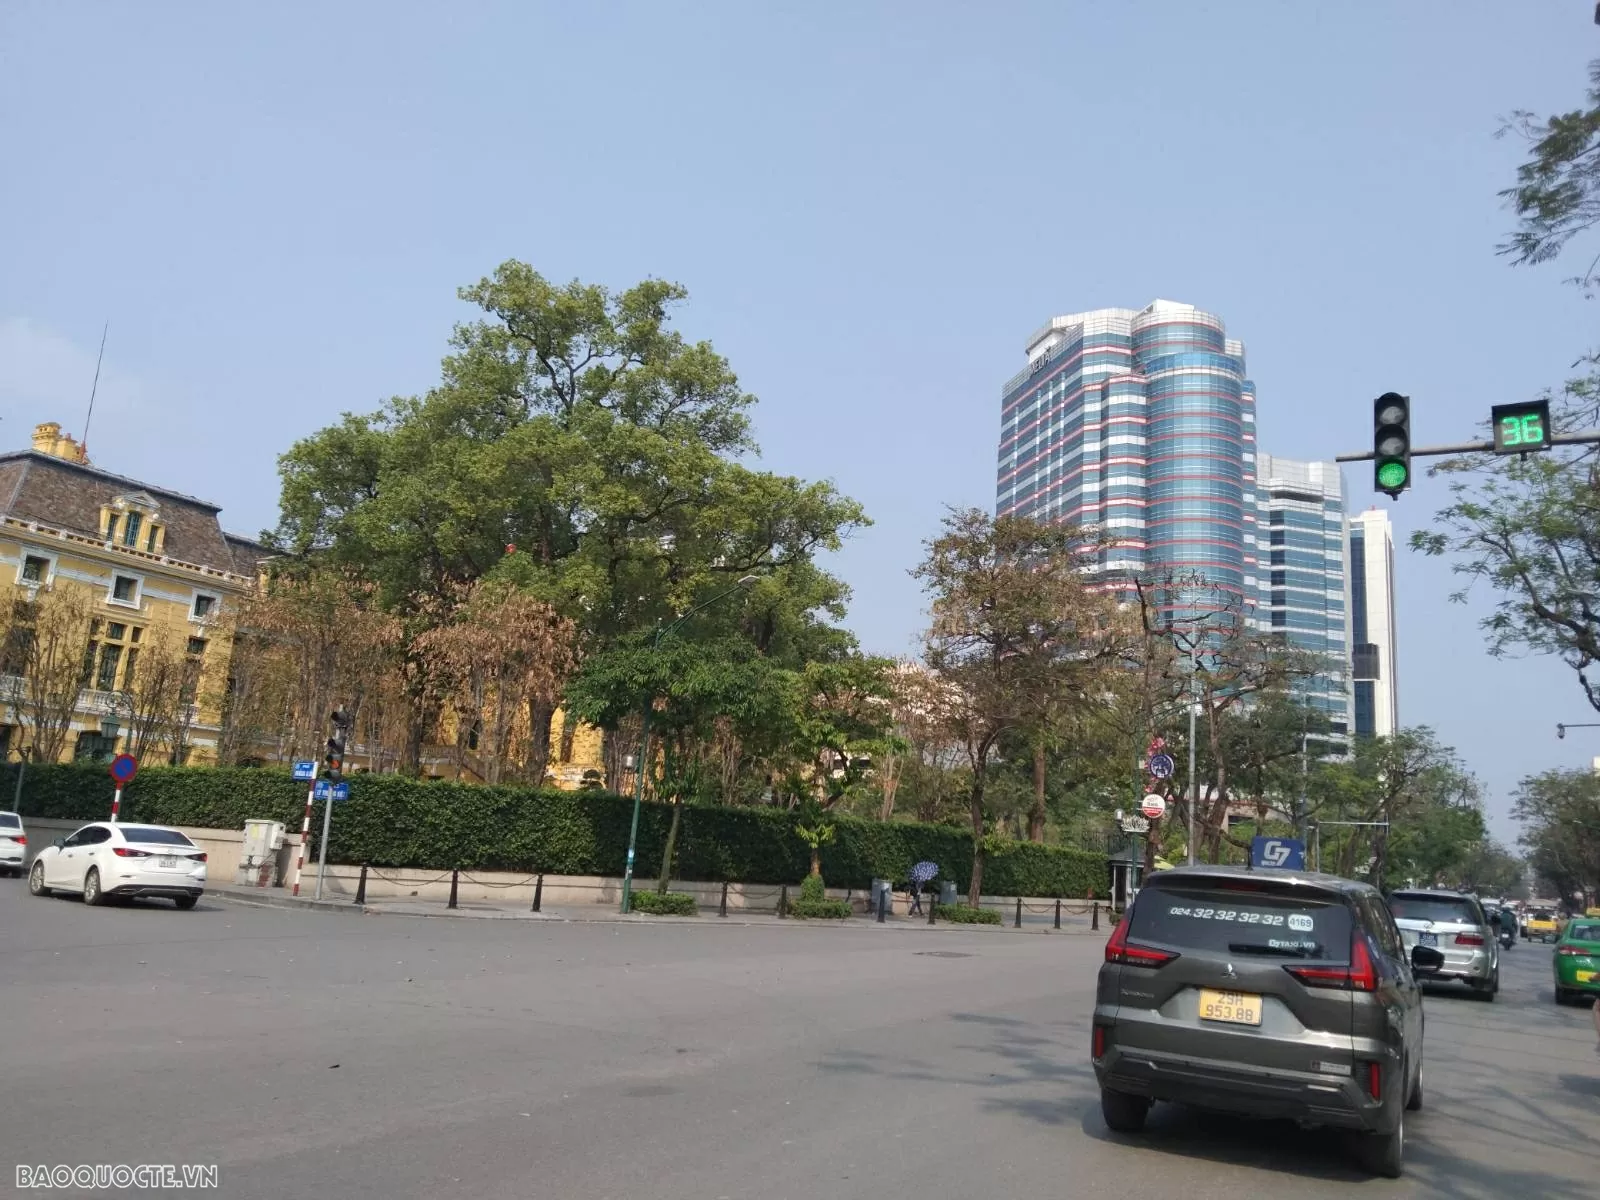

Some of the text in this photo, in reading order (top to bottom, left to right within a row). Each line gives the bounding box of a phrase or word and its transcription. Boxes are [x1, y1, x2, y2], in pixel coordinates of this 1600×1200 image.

[1502, 413, 1544, 446] 36
[1264, 841, 1292, 866] G7
[1215, 910, 1237, 921] 32
[1238, 912, 1260, 923] 32
[1262, 914, 1284, 926] 32
